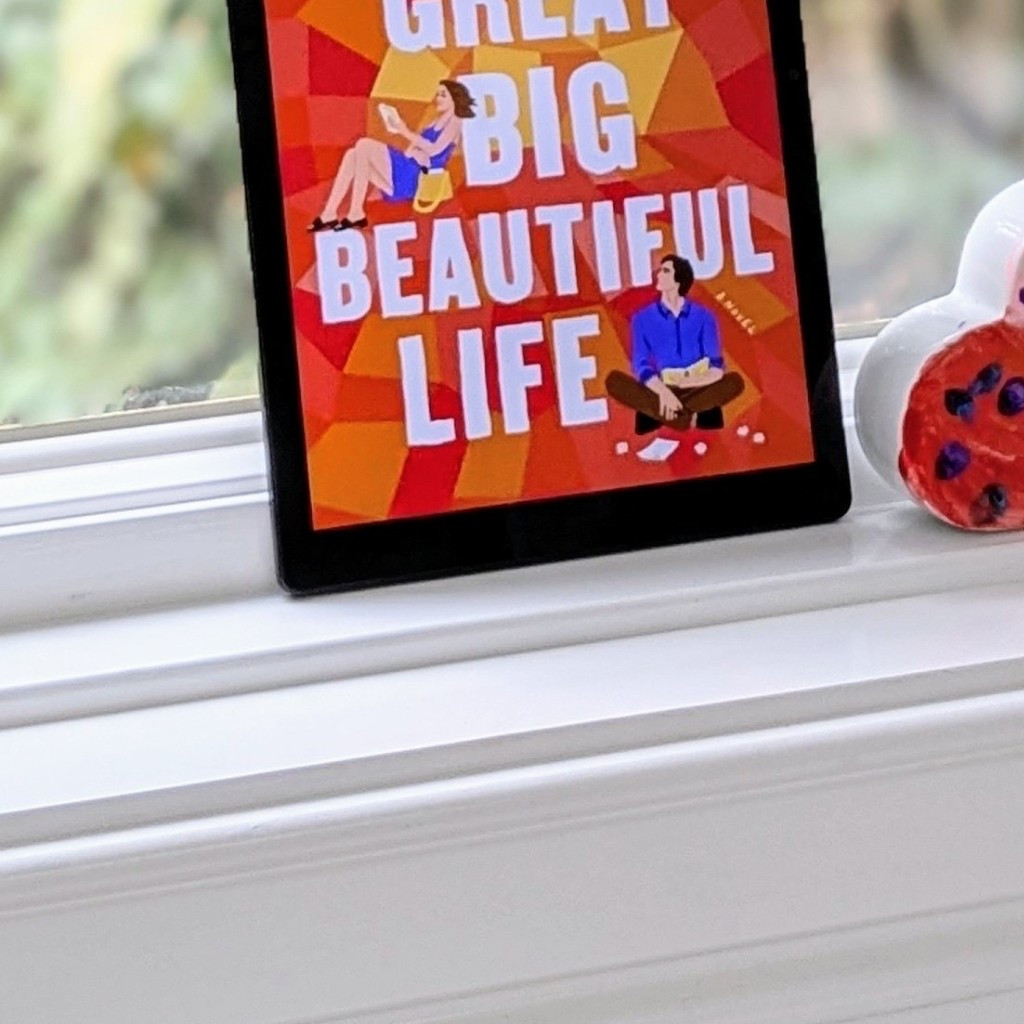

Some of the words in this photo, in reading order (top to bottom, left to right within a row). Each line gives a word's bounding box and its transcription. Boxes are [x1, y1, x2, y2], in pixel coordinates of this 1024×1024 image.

[457, 61, 638, 187] BIG
[315, 184, 775, 325] BEAUTIFUL
[398, 313, 610, 447] LIFE
